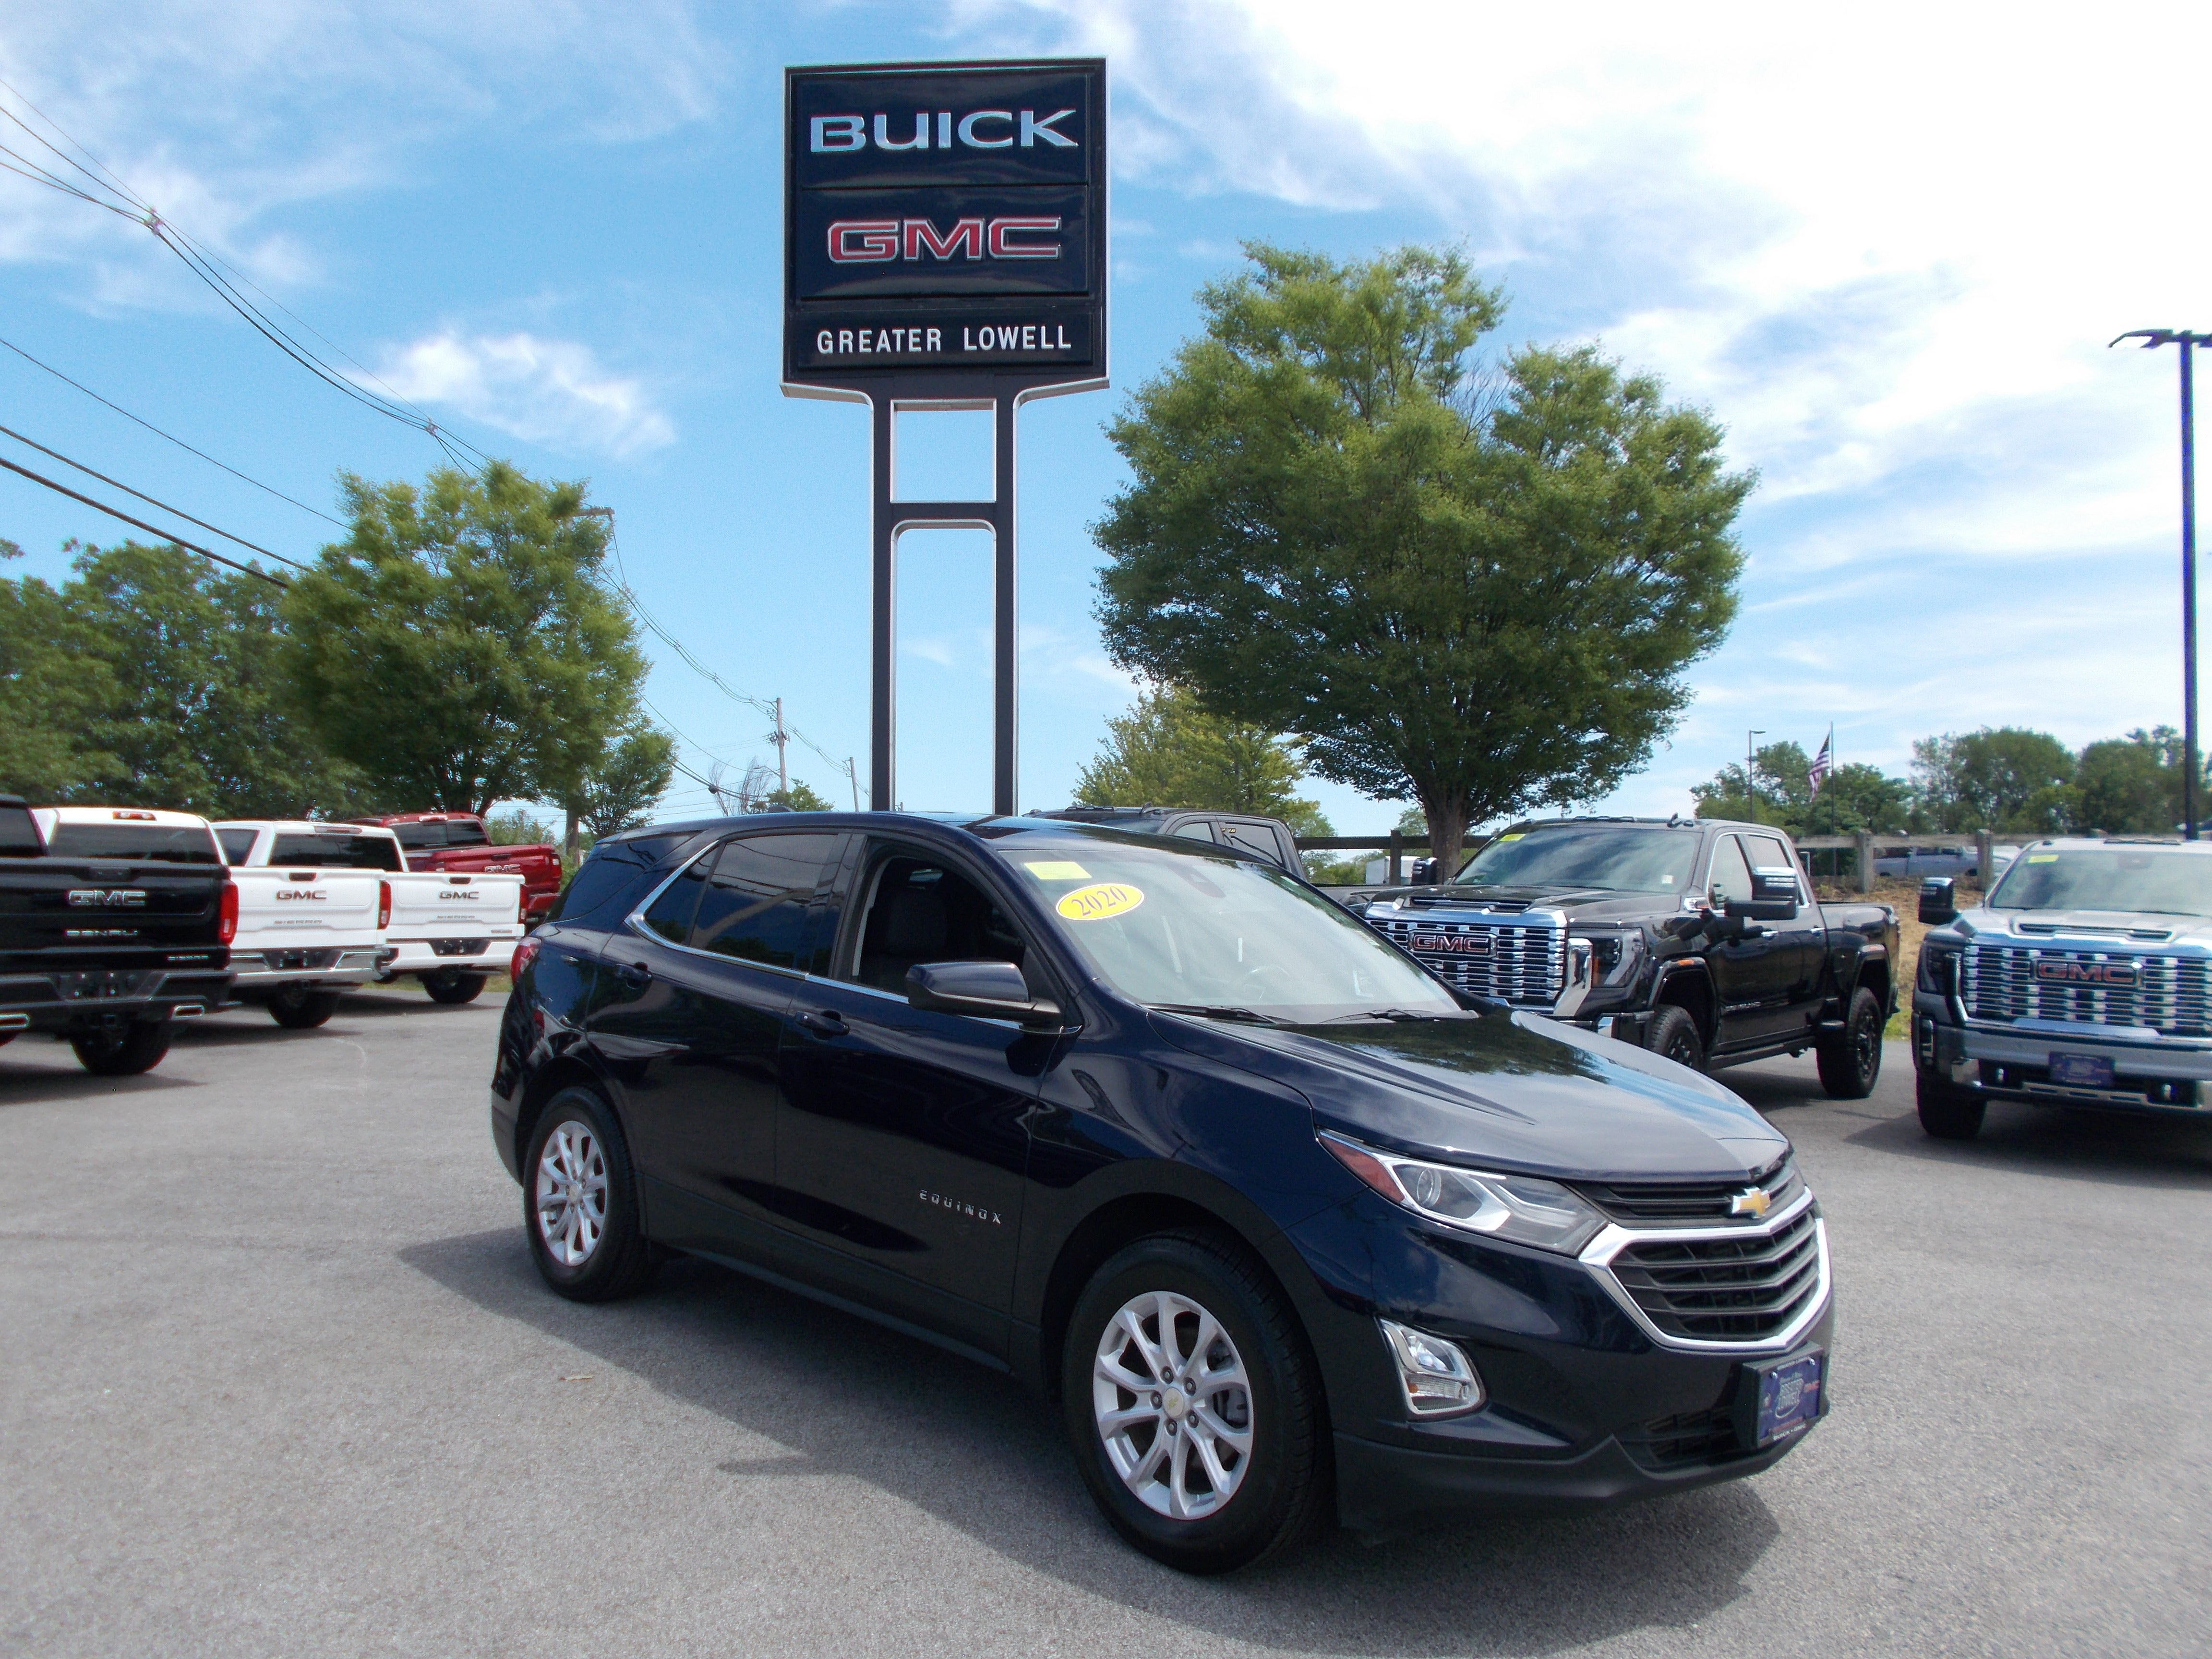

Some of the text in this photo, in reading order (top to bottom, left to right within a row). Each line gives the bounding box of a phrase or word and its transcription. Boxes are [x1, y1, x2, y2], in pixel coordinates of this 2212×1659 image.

[810, 109, 1079, 153] BUICK
[827, 216, 1061, 264] GMC
[817, 325, 1072, 354] GREATER LOWELL
[484, 864, 521, 873] GMC
[69, 890, 145, 906] GMC
[276, 890, 327, 901] GMC
[439, 891, 479, 899] GMC
[1071, 886, 1128, 916] 2020
[1413, 934, 1489, 953] GMC
[2039, 962, 2134, 983] GMC
[919, 1190, 1001, 1224] EQUINOX
